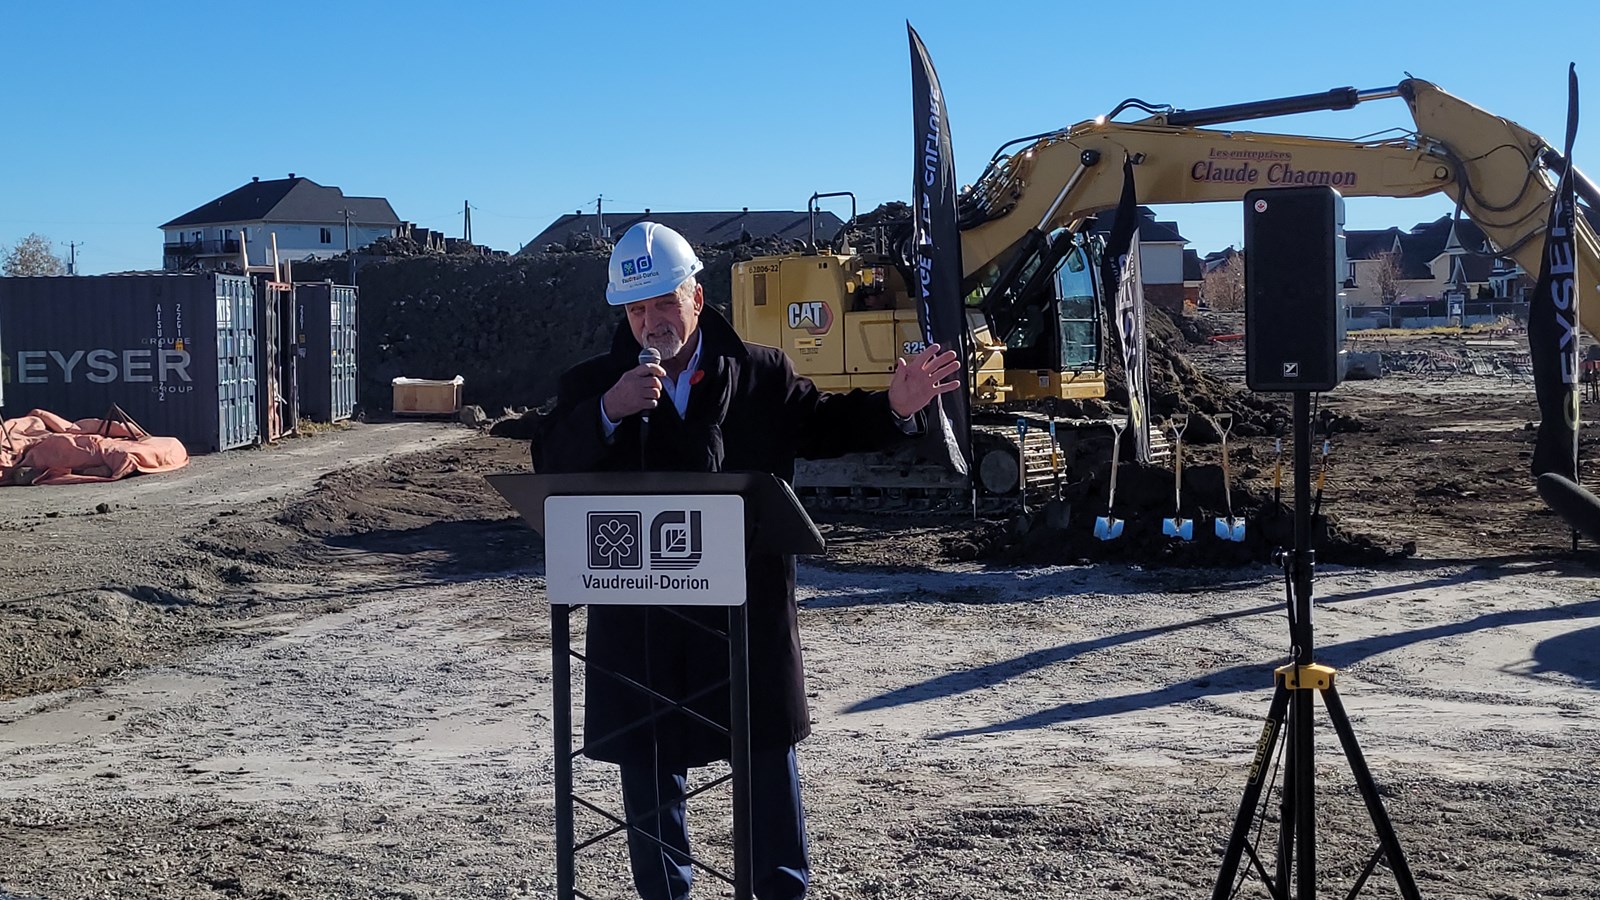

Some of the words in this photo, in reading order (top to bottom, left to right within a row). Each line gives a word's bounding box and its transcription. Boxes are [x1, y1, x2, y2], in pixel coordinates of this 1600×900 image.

[1209, 148, 1229, 160] Les
[1230, 149, 1293, 162] entreprises
[1191, 160, 1259, 184] Claude
[1267, 162, 1358, 187] Chagnon
[788, 302, 823, 329] CAT
[903, 341, 926, 354] 325
[2, 350, 193, 383] EYSER
[152, 385, 193, 393] GROUP
[581, 574, 709, 590] Vaudreuil-Dorion
[1248, 720, 1273, 778] HERCULES
